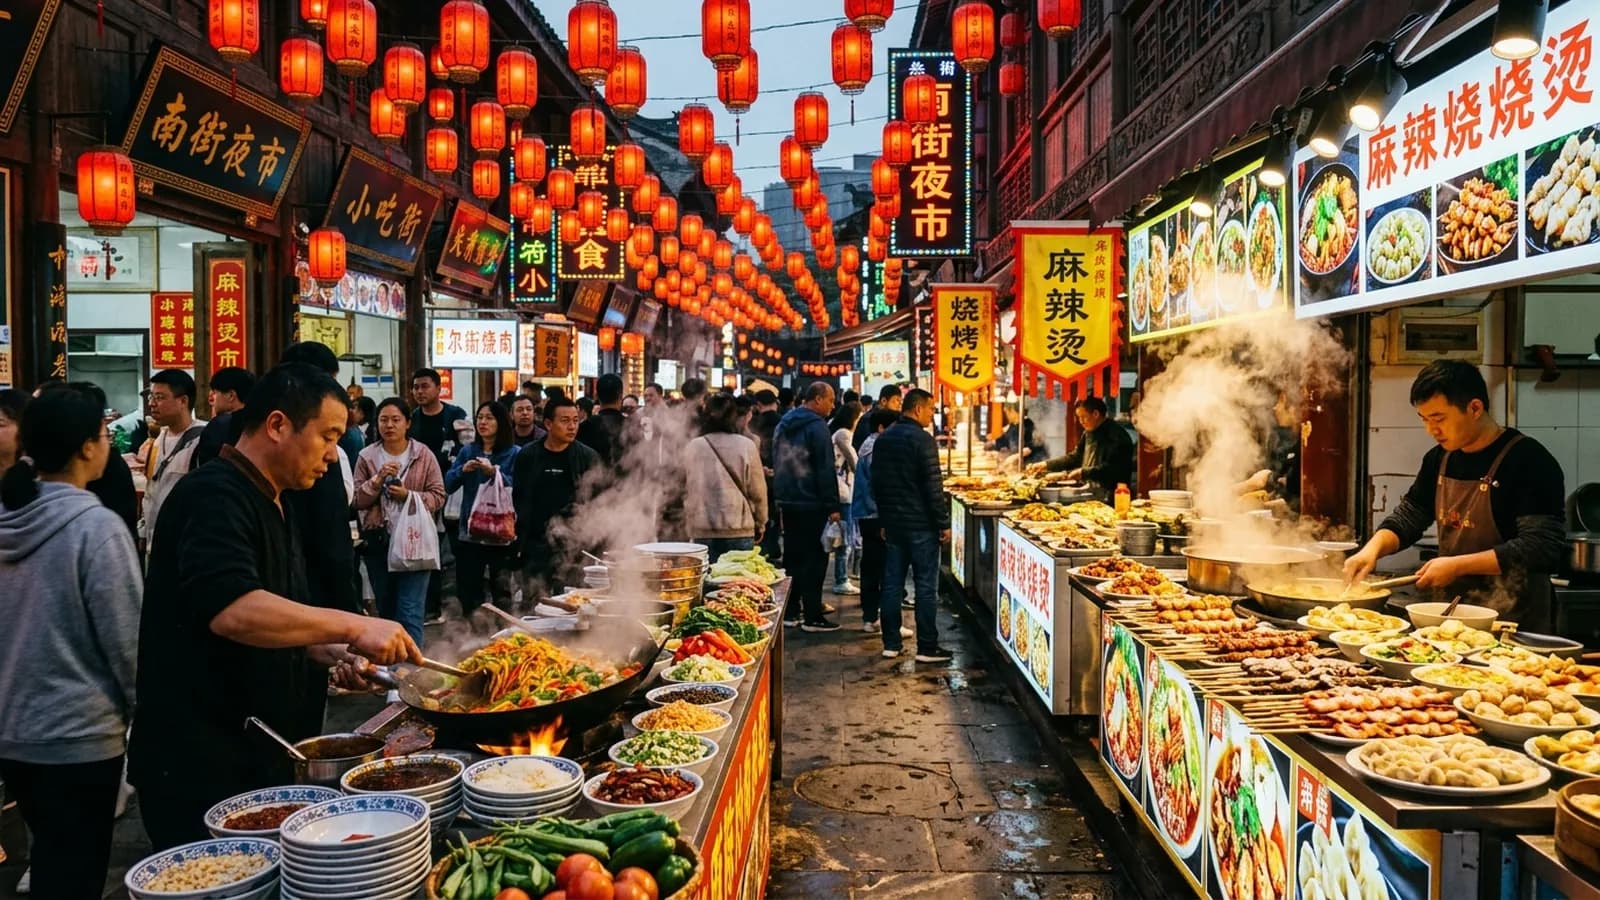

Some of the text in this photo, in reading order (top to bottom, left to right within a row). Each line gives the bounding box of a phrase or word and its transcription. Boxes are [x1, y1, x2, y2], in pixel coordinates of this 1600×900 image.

[152, 92, 286, 187] 南街夜市
[1366, 19, 1594, 190] 麻辣烧烧烫
[346, 184, 423, 246] 小吃街
[951, 296, 979, 378] 烧烤吃
[1044, 248, 1088, 365] 麻辣烫
